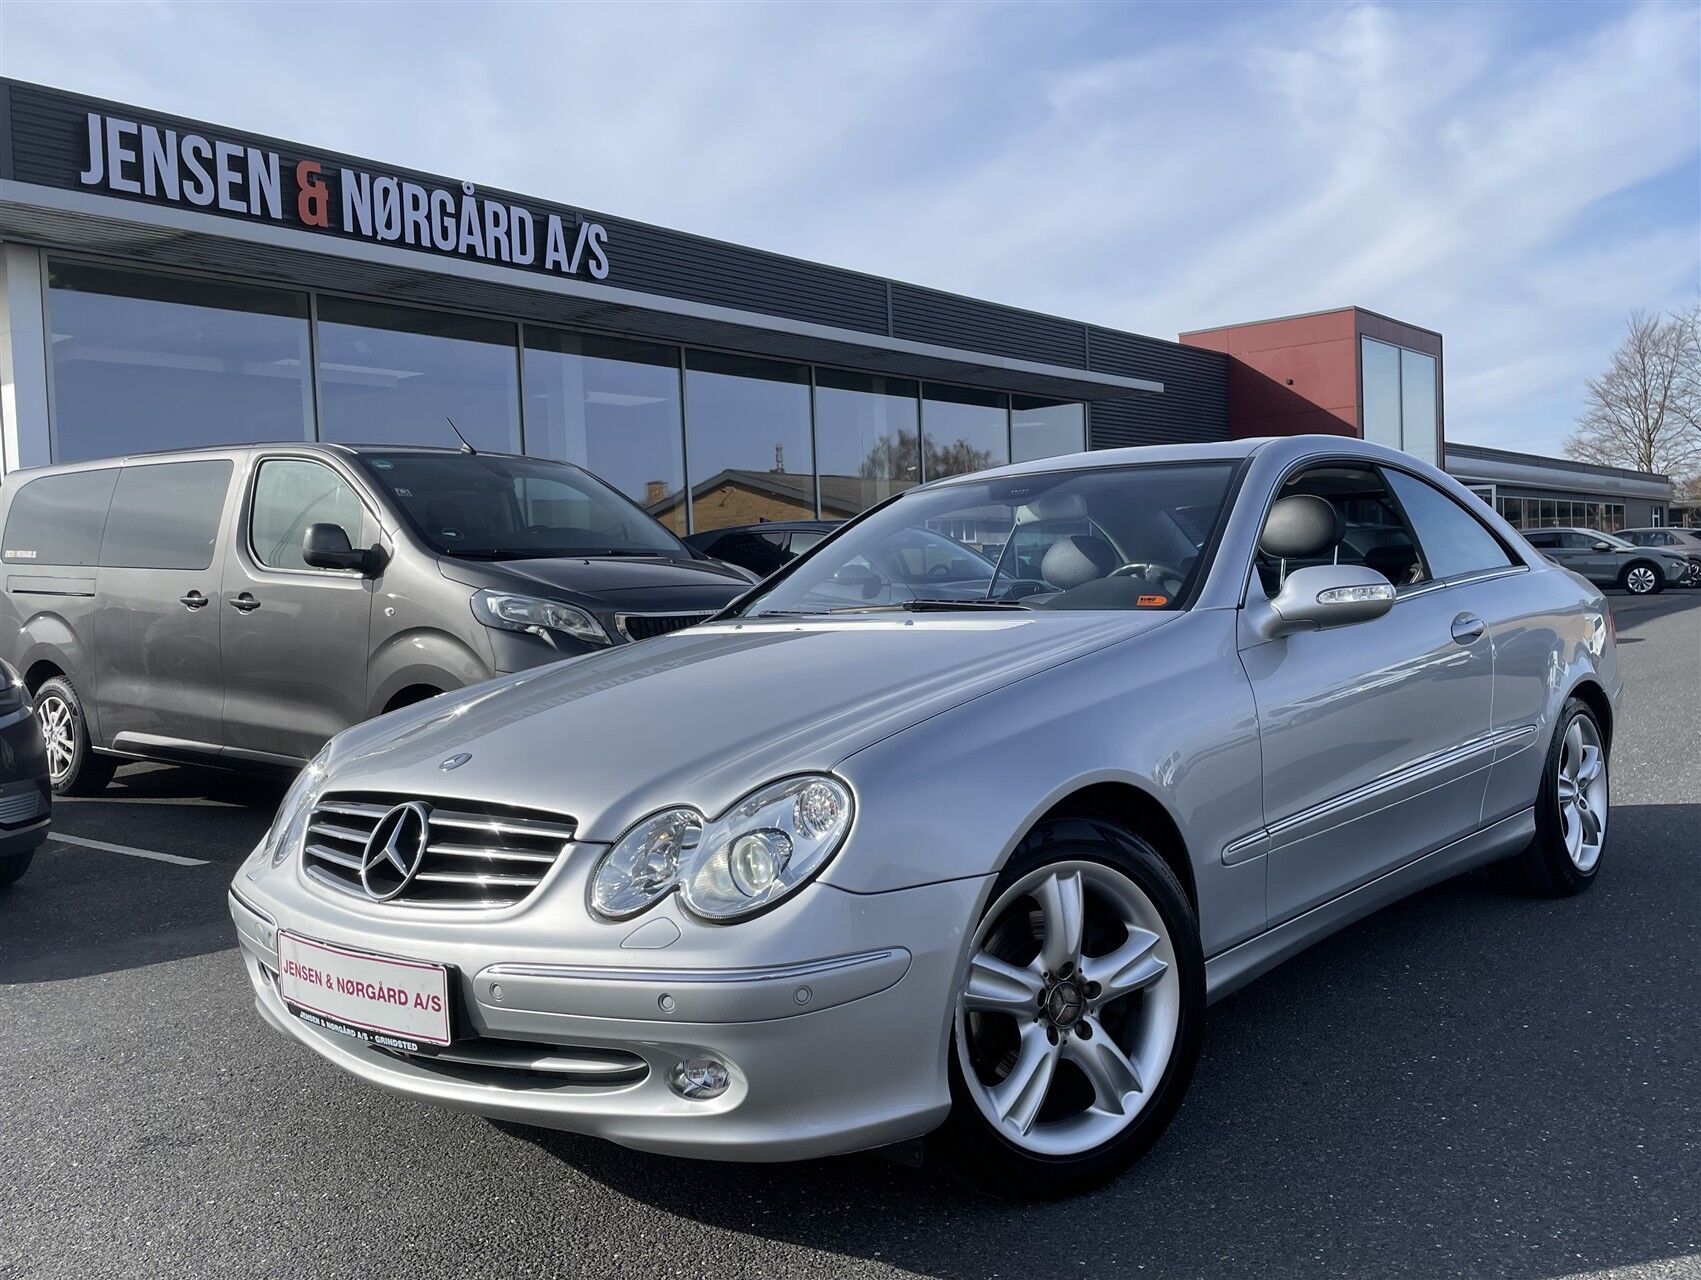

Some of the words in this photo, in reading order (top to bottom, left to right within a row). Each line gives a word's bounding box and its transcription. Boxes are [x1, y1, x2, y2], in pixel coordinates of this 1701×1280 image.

[80, 112, 283, 219] JENSEN
[296, 160, 328, 228] &
[341, 168, 535, 265] NØRGÅRD
[545, 214, 609, 279] A/S
[283, 959, 322, 986] JENSEN
[326, 973, 334, 990] &
[336, 977, 408, 1006] NØRGÅRD
[413, 992, 442, 1012] A/S
[300, 1011, 320, 1025] JENSEN
[321, 1019, 326, 1027] &
[357, 1031, 369, 1041] A/S
[374, 1035, 418, 1051] GRINDSTED
